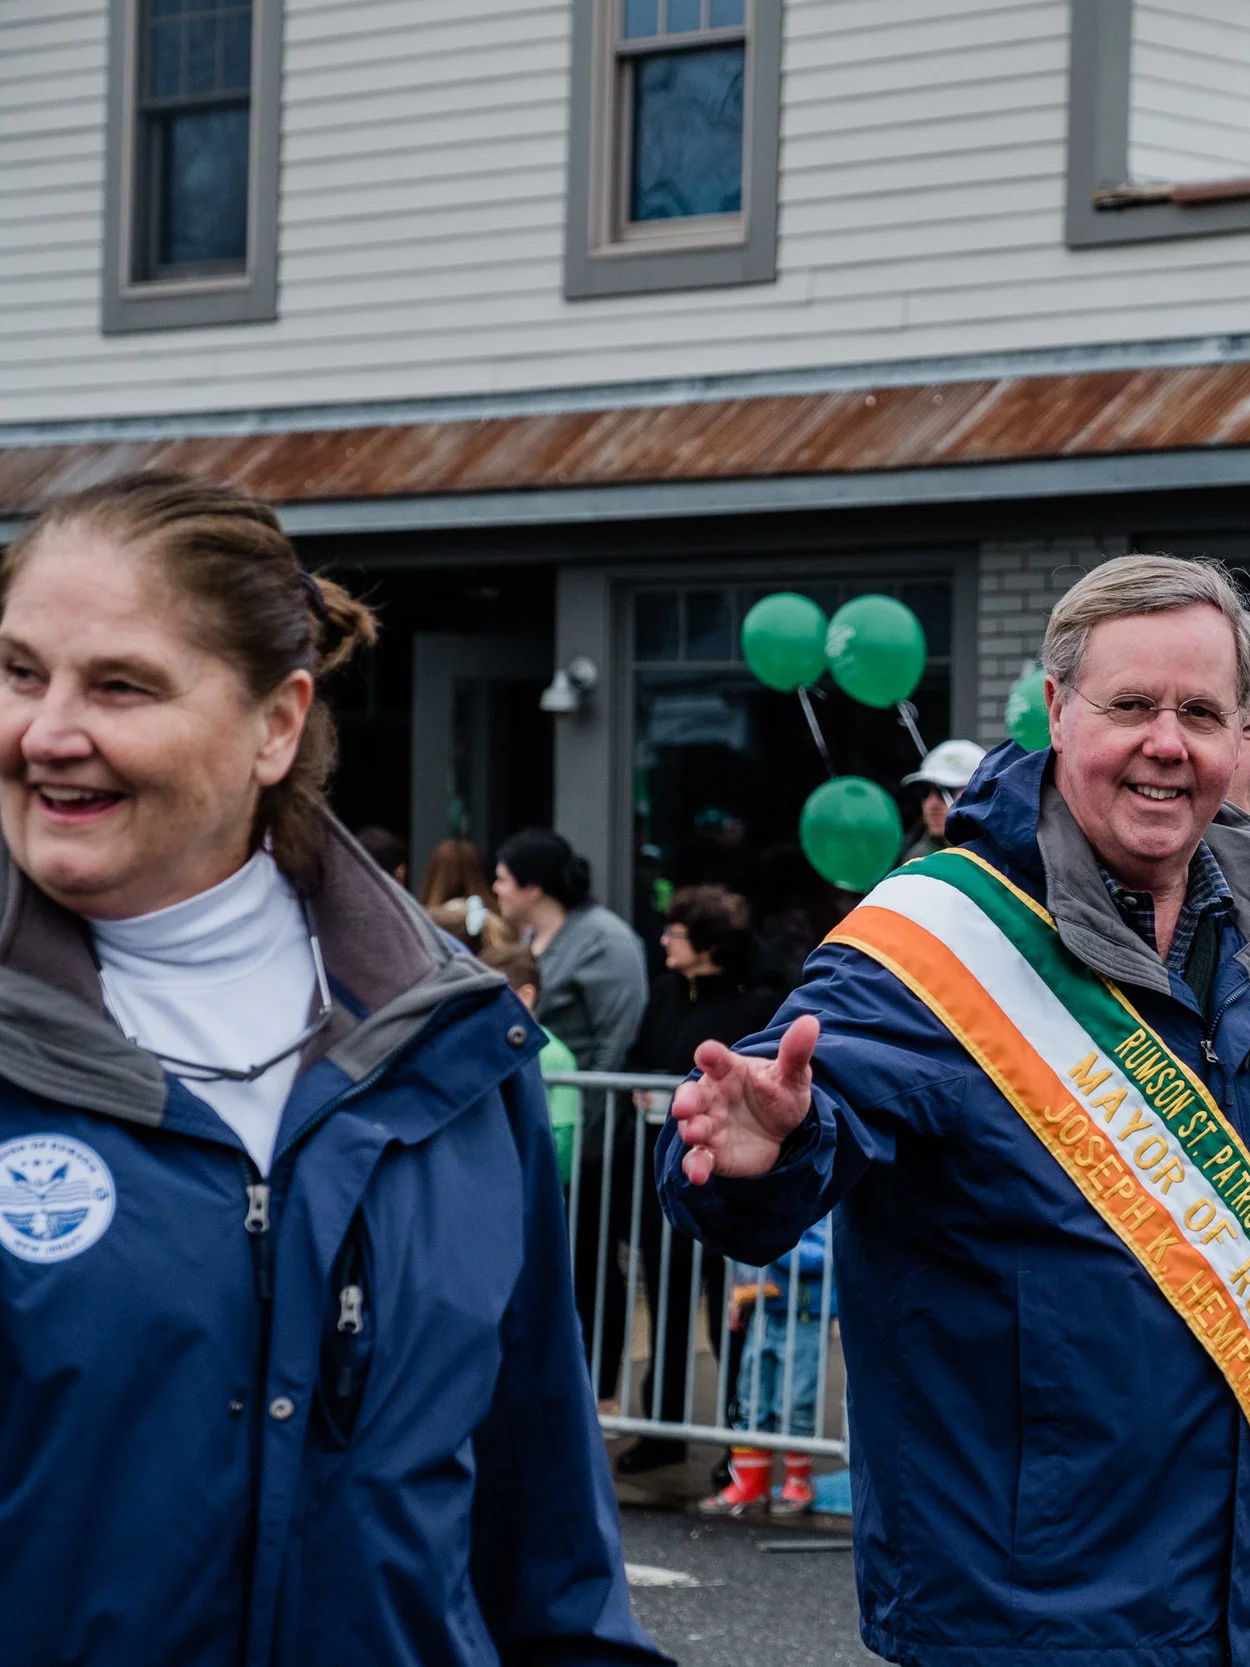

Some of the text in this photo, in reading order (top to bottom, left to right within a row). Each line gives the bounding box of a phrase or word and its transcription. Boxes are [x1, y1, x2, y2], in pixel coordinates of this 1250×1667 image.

[1067, 1051, 1185, 1195] MAYOR
[1183, 1197, 1238, 1245] OF
[1114, 1028, 1195, 1121] RUMSON
[1178, 1110, 1218, 1157] ST.
[1044, 1102, 1156, 1232] JOSEPH
[1144, 1227, 1180, 1274] K.
